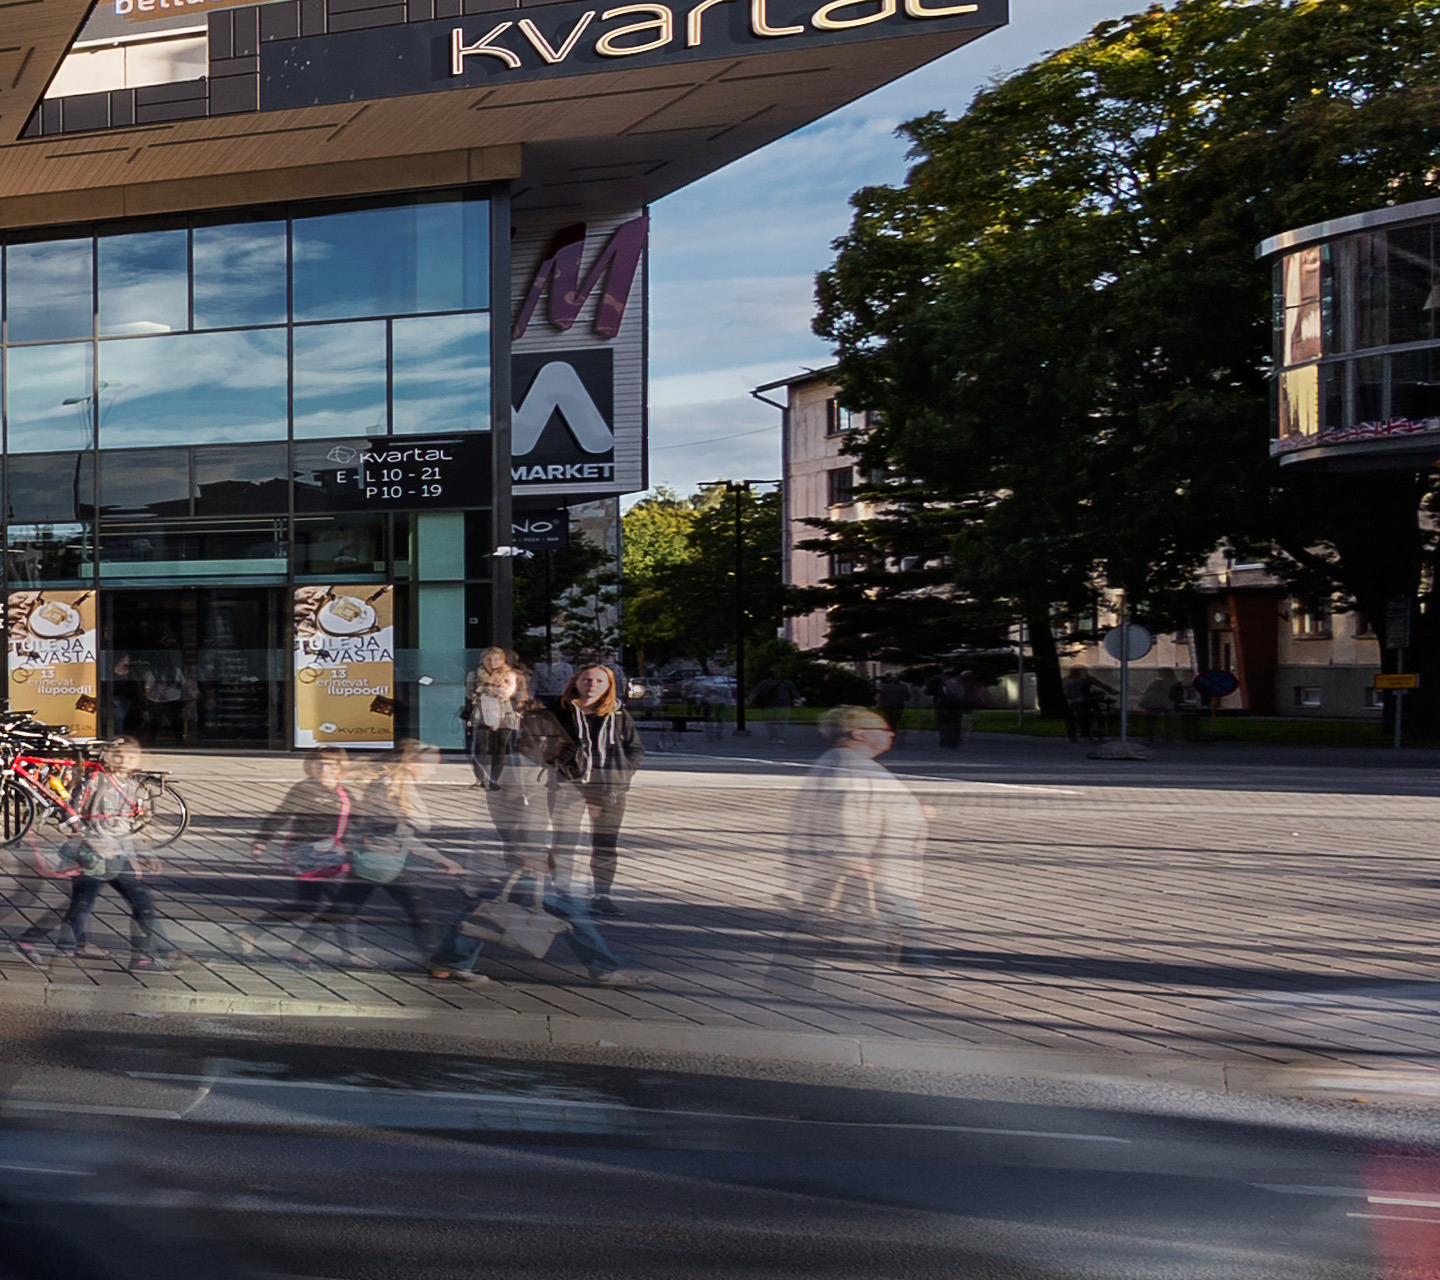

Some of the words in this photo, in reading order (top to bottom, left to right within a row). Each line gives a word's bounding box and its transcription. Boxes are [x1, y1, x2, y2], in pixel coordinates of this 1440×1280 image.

[337, 471, 347, 483] E
[366, 470, 376, 482] L
[381, 468, 402, 481] 10
[421, 467, 442, 480] 21
[366, 486, 377, 499] P
[381, 486, 402, 498] 10
[421, 484, 442, 497] 19
[61, 638, 84, 651] JA
[354, 636, 380, 649] JA
[26, 650, 96, 663] AVASTA
[314, 649, 394, 663] AVASTA
[41, 670, 56, 678] 13
[331, 670, 347, 678] 13
[38, 686, 93, 695] ilupoodi!
[327, 686, 390, 696] ilupoodi!
